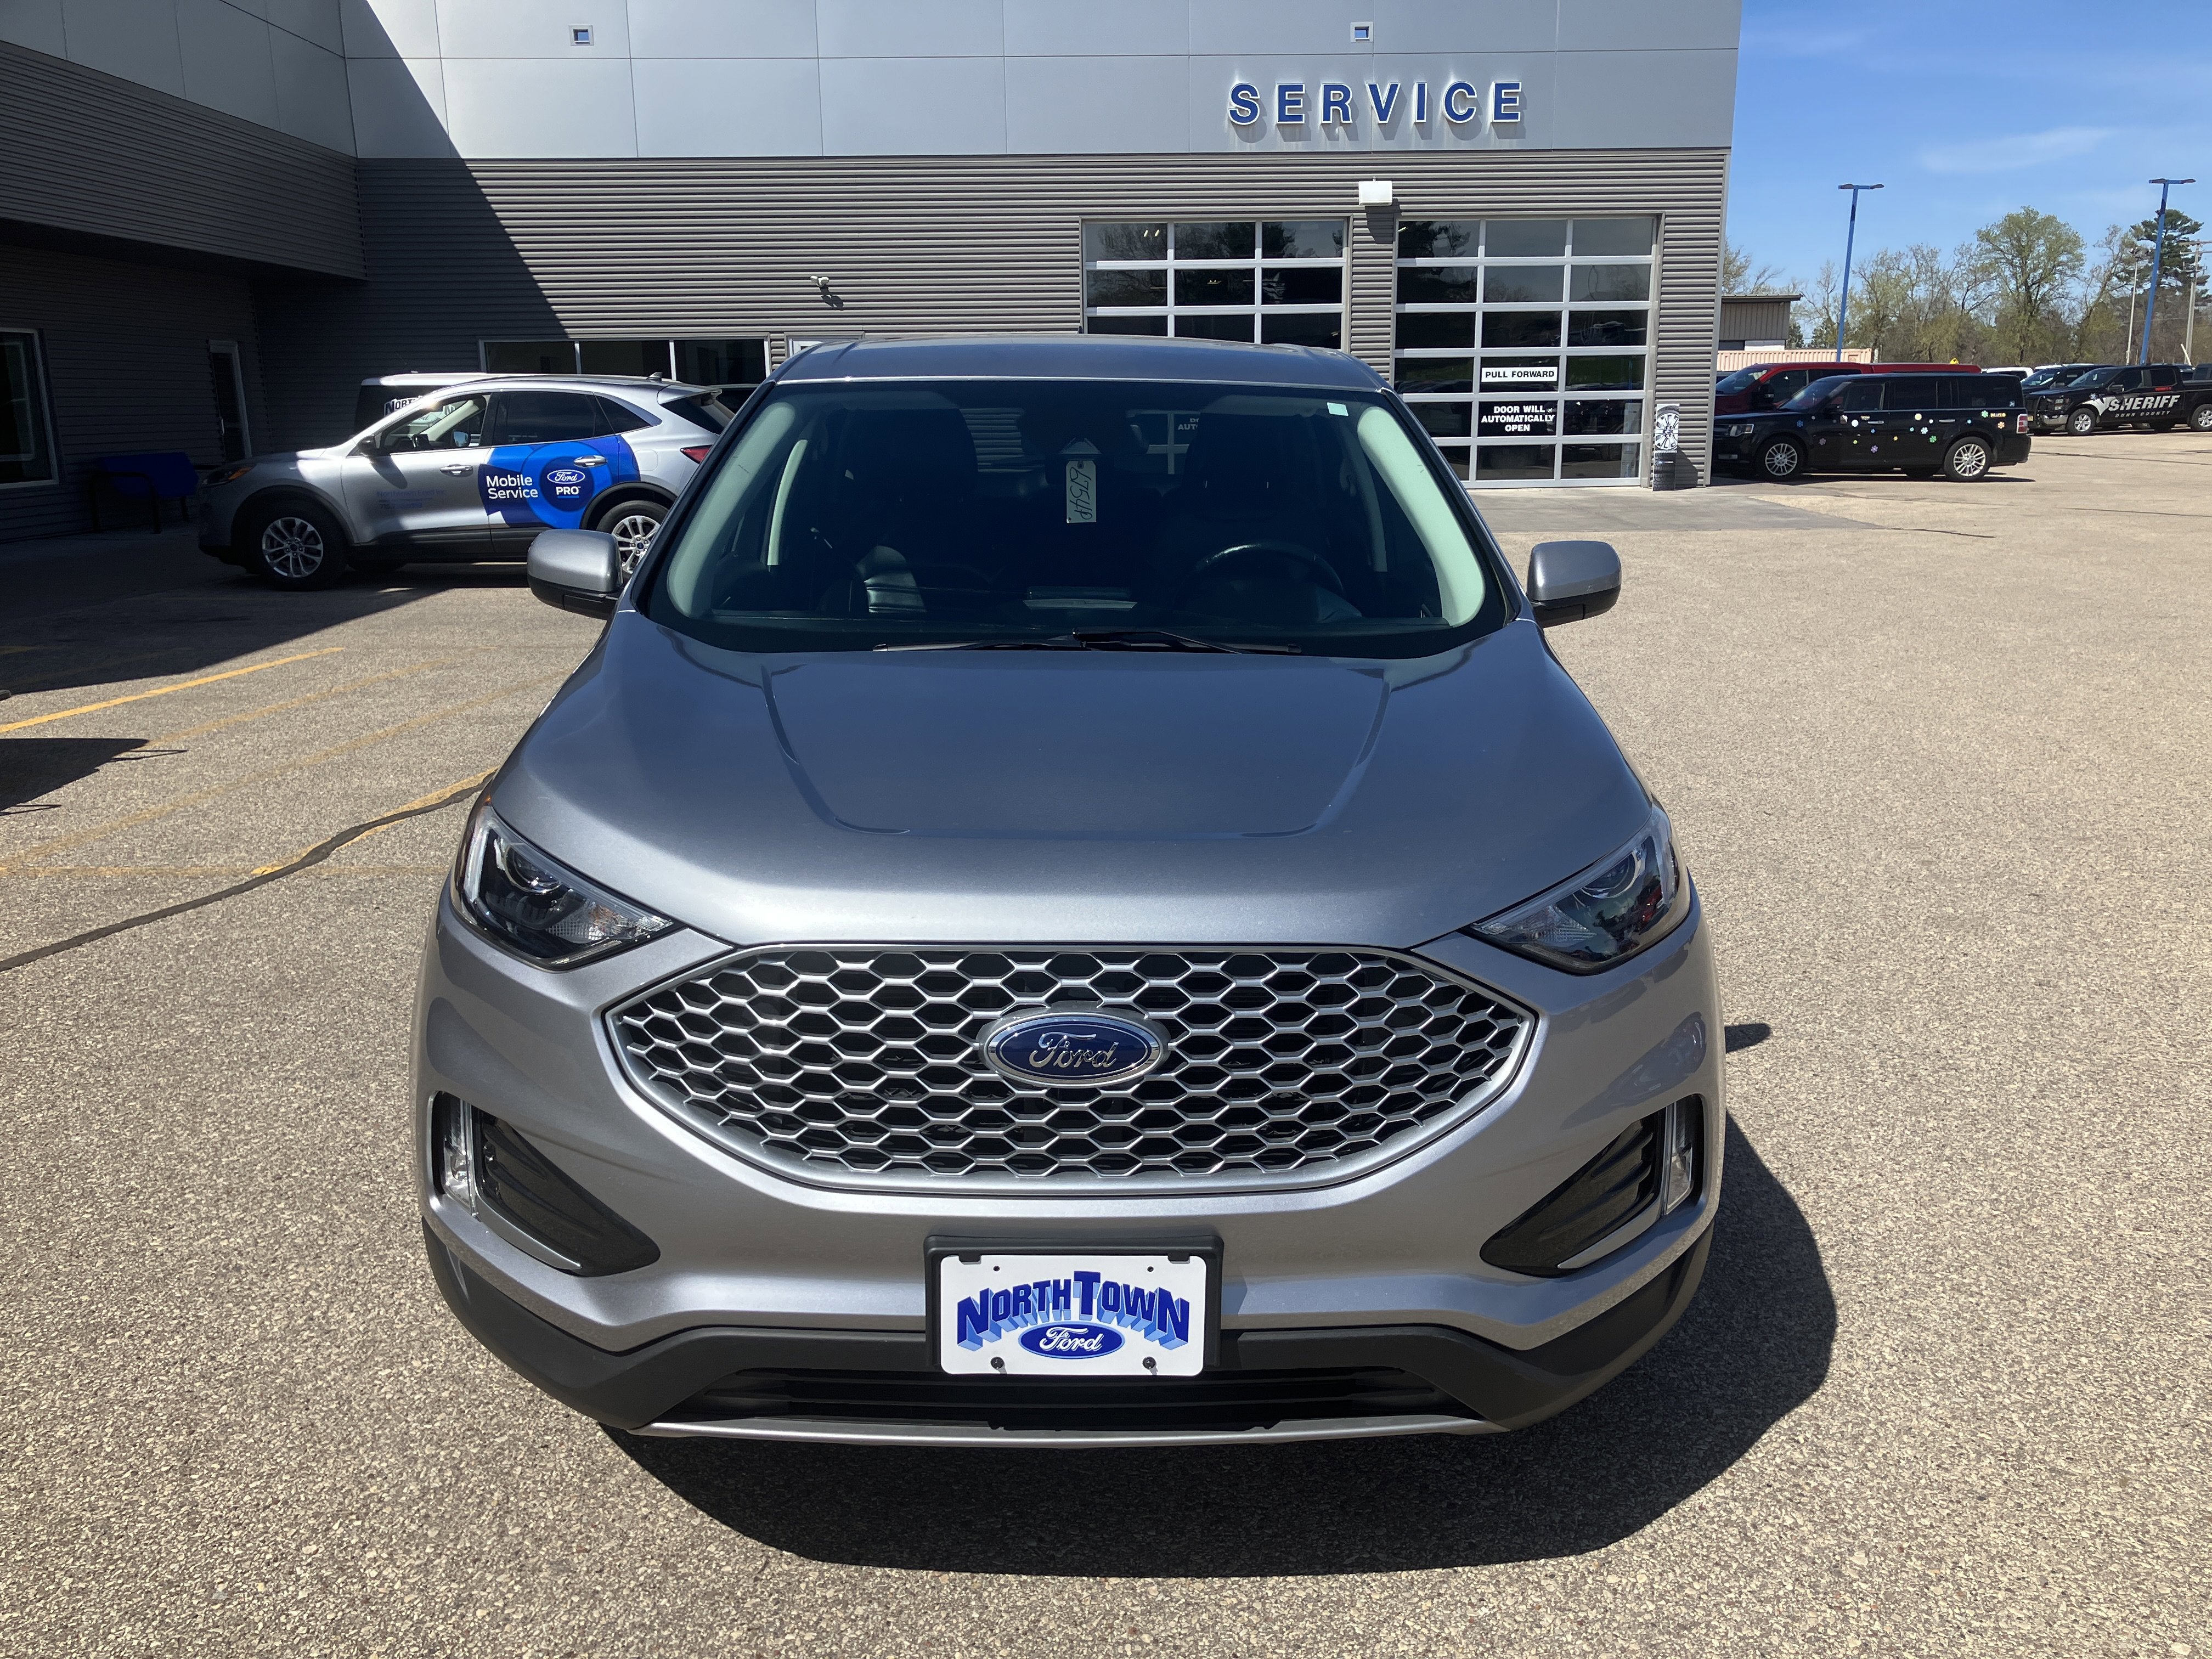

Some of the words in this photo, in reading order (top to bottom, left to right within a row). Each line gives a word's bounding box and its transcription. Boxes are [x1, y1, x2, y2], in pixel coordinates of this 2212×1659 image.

[1228, 80, 1522, 125] SERVICE
[1493, 405, 1520, 414] DOOR
[1523, 405, 1545, 413] WILL
[2108, 395, 2181, 411] SHERIFF
[1481, 414, 1555, 423] AUTOMATICALLY
[486, 474, 533, 487] Mobile
[554, 471, 578, 482] Ford
[488, 487, 538, 499] Service
[1069, 467, 1093, 520] 6754P
[1029, 1031, 1119, 1068] Ford
[1039, 1327, 1103, 1352] Ford
